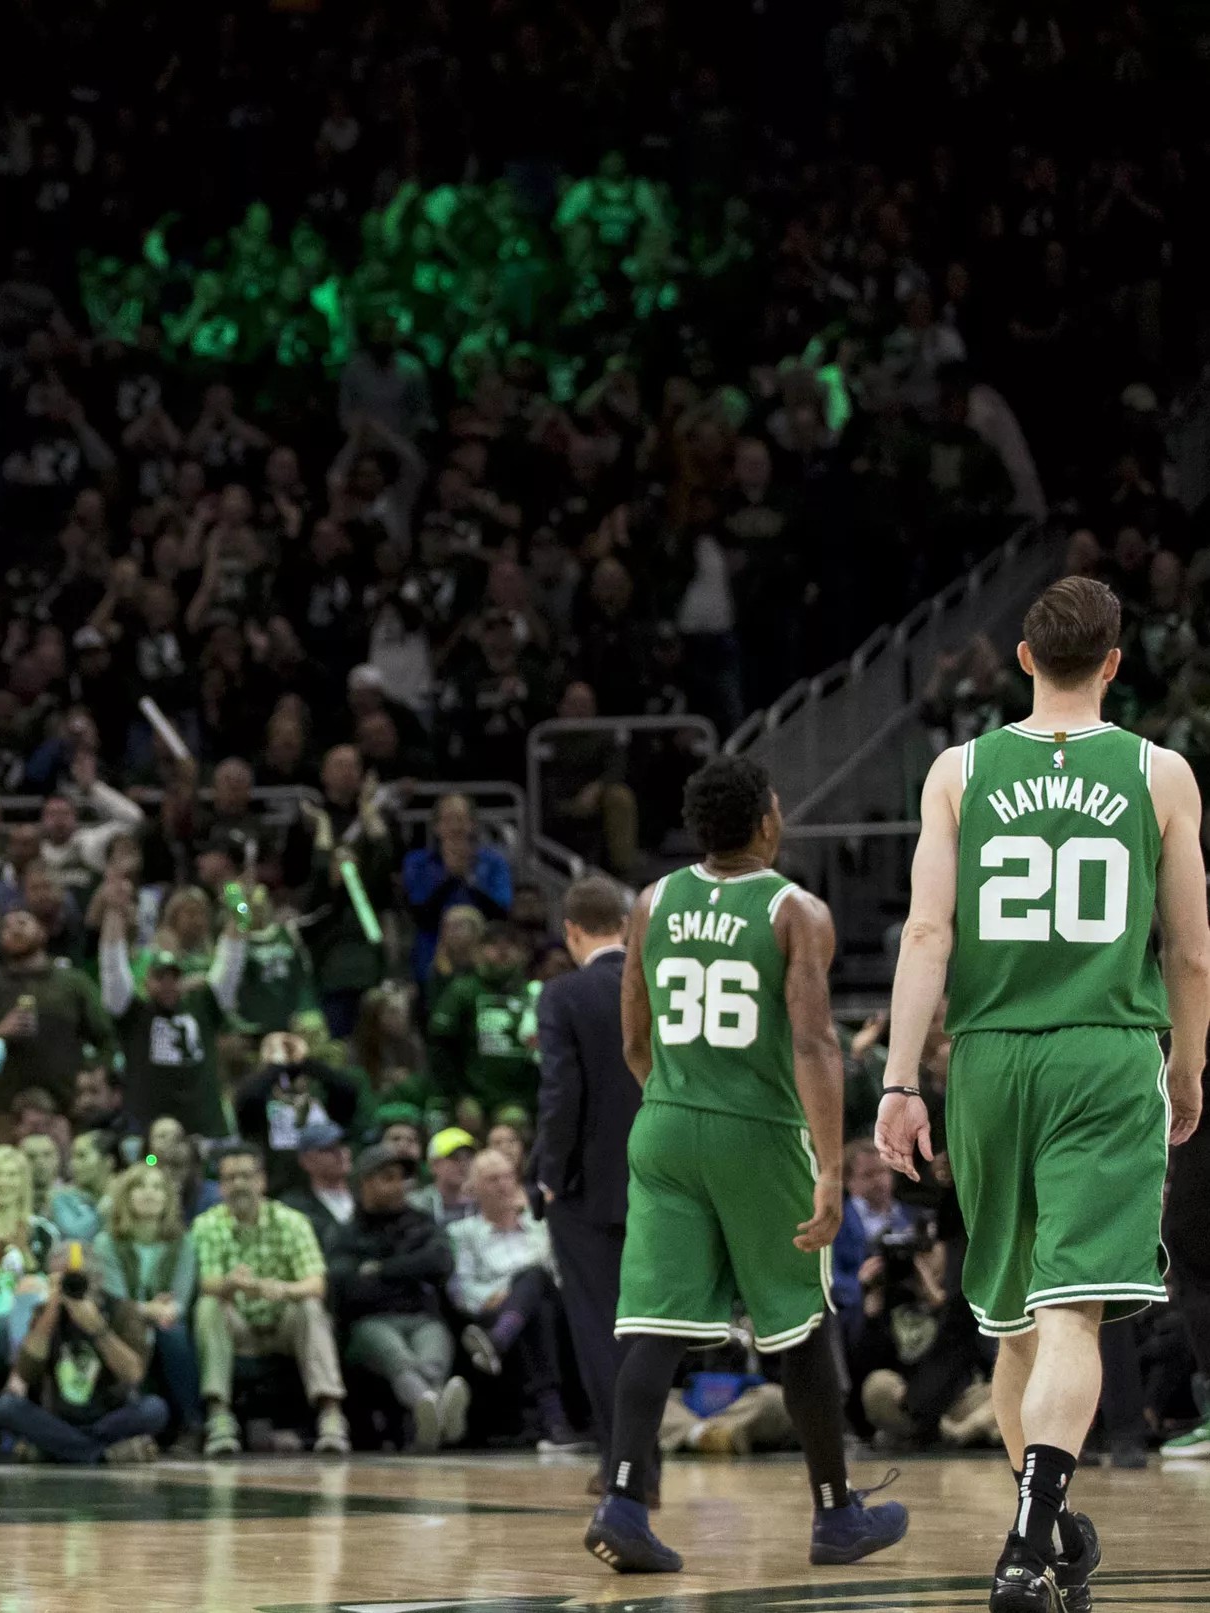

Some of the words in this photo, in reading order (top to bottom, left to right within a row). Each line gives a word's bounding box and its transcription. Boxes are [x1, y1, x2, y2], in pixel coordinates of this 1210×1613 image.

[987, 776, 1129, 826] HAYWARD
[979, 836, 1130, 943] 20
[667, 910, 748, 947] SMART
[656, 957, 759, 1049] 36
